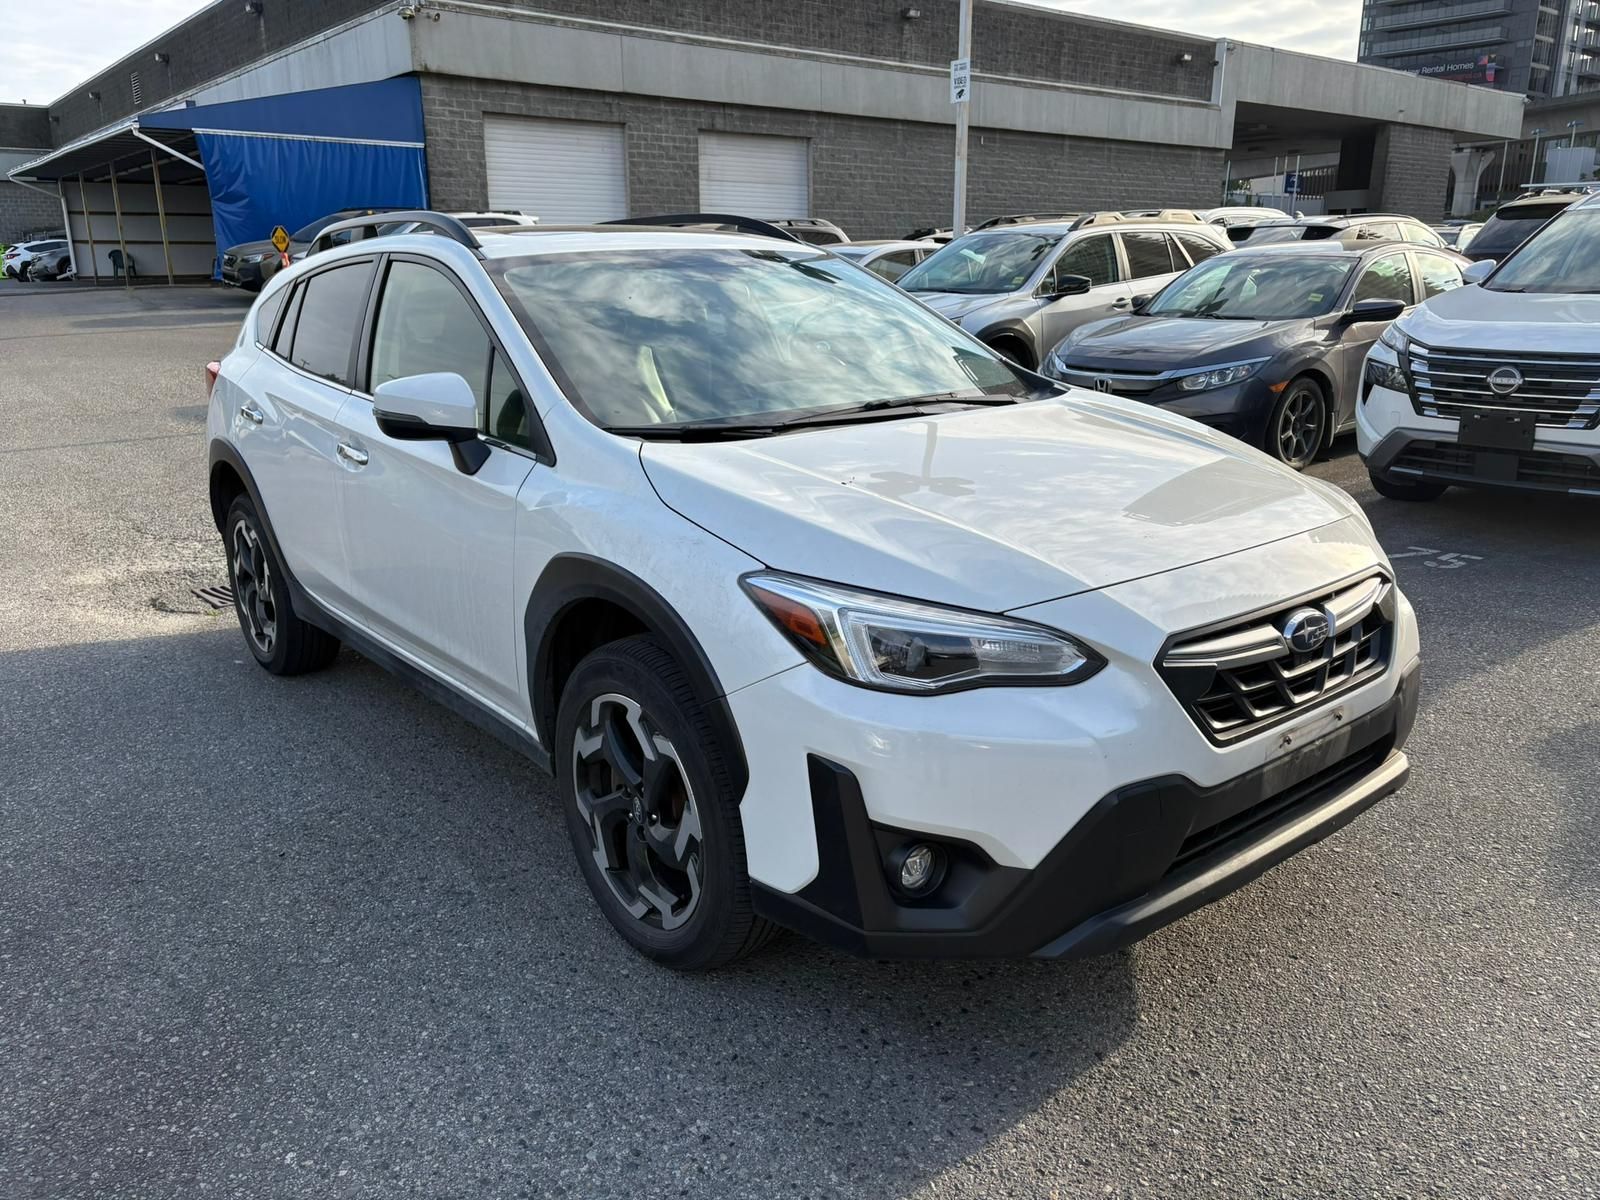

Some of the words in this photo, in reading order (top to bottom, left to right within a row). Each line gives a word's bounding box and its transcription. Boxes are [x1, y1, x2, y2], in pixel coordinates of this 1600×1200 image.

[1421, 64, 1446, 74] Rental
[1446, 62, 1474, 72] Homes
[1486, 376, 1523, 385] NISSAN
[1388, 546, 1484, 569] 75
